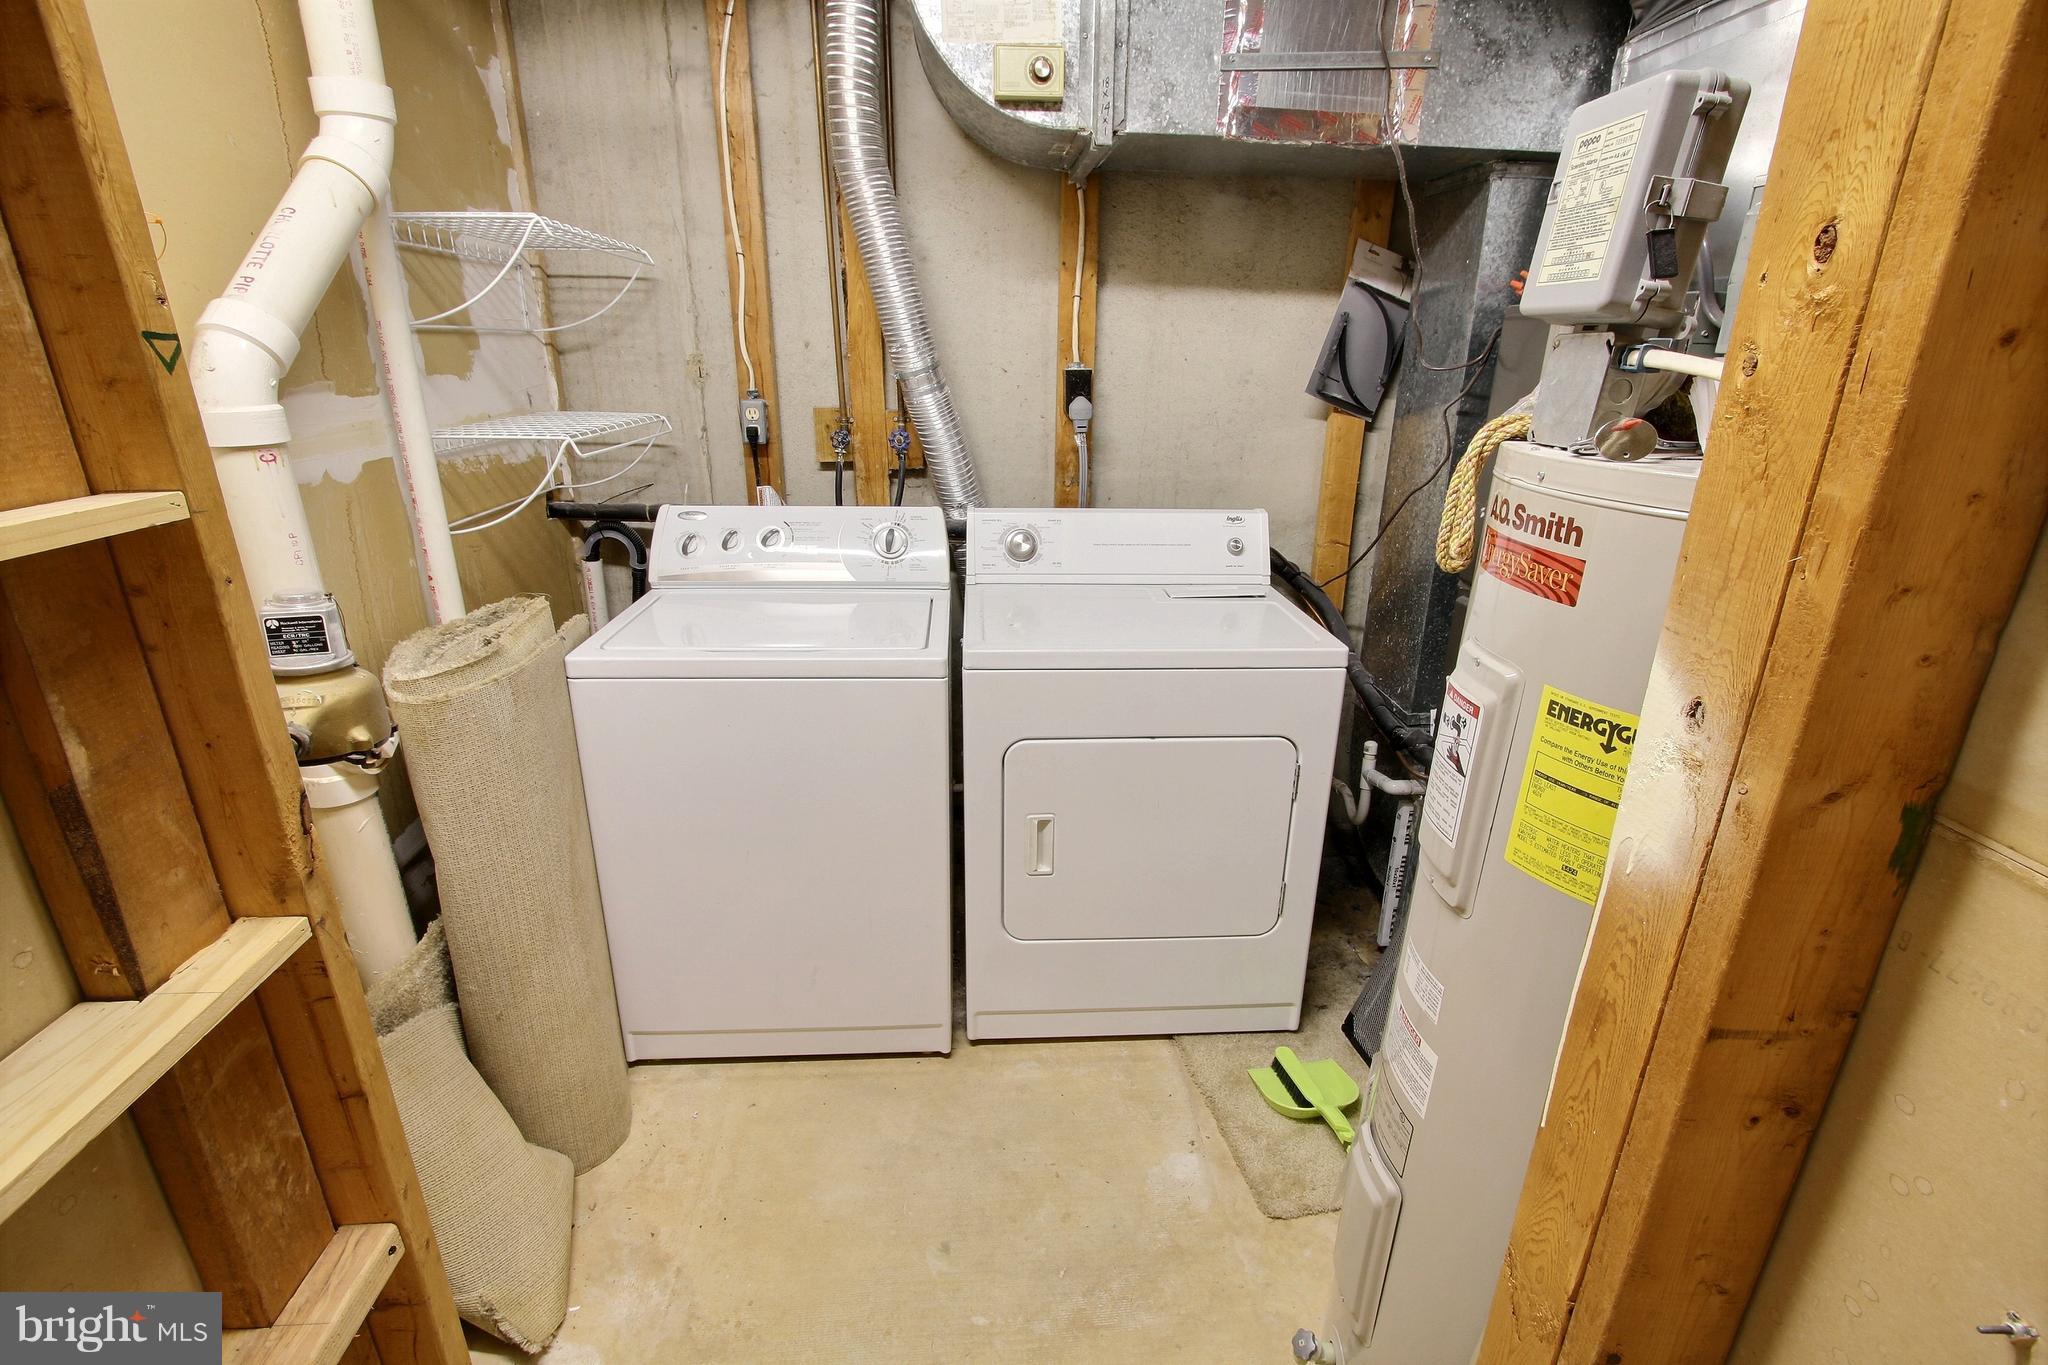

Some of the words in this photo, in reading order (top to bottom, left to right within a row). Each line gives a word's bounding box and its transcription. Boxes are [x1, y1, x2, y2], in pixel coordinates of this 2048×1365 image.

[1578, 134, 1601, 152] pepco
[246, 207, 296, 269] CHLOTTE
[1512, 503, 1584, 547] Smith
[1453, 693, 1475, 716] DANGER
[1540, 735, 1563, 752] Compare
[1564, 744, 1574, 755] the
[1574, 748, 1595, 764] Energy
[1596, 757, 1608, 769] Use
[1609, 762, 1617, 771] of
[1617, 763, 1627, 775] thi
[1561, 755, 1574, 765] with
[1574, 758, 1594, 773] Others
[1594, 767, 1615, 780] Before
[1615, 773, 1625, 782] Yo
[1577, 860, 1603, 878] OPERATIN
